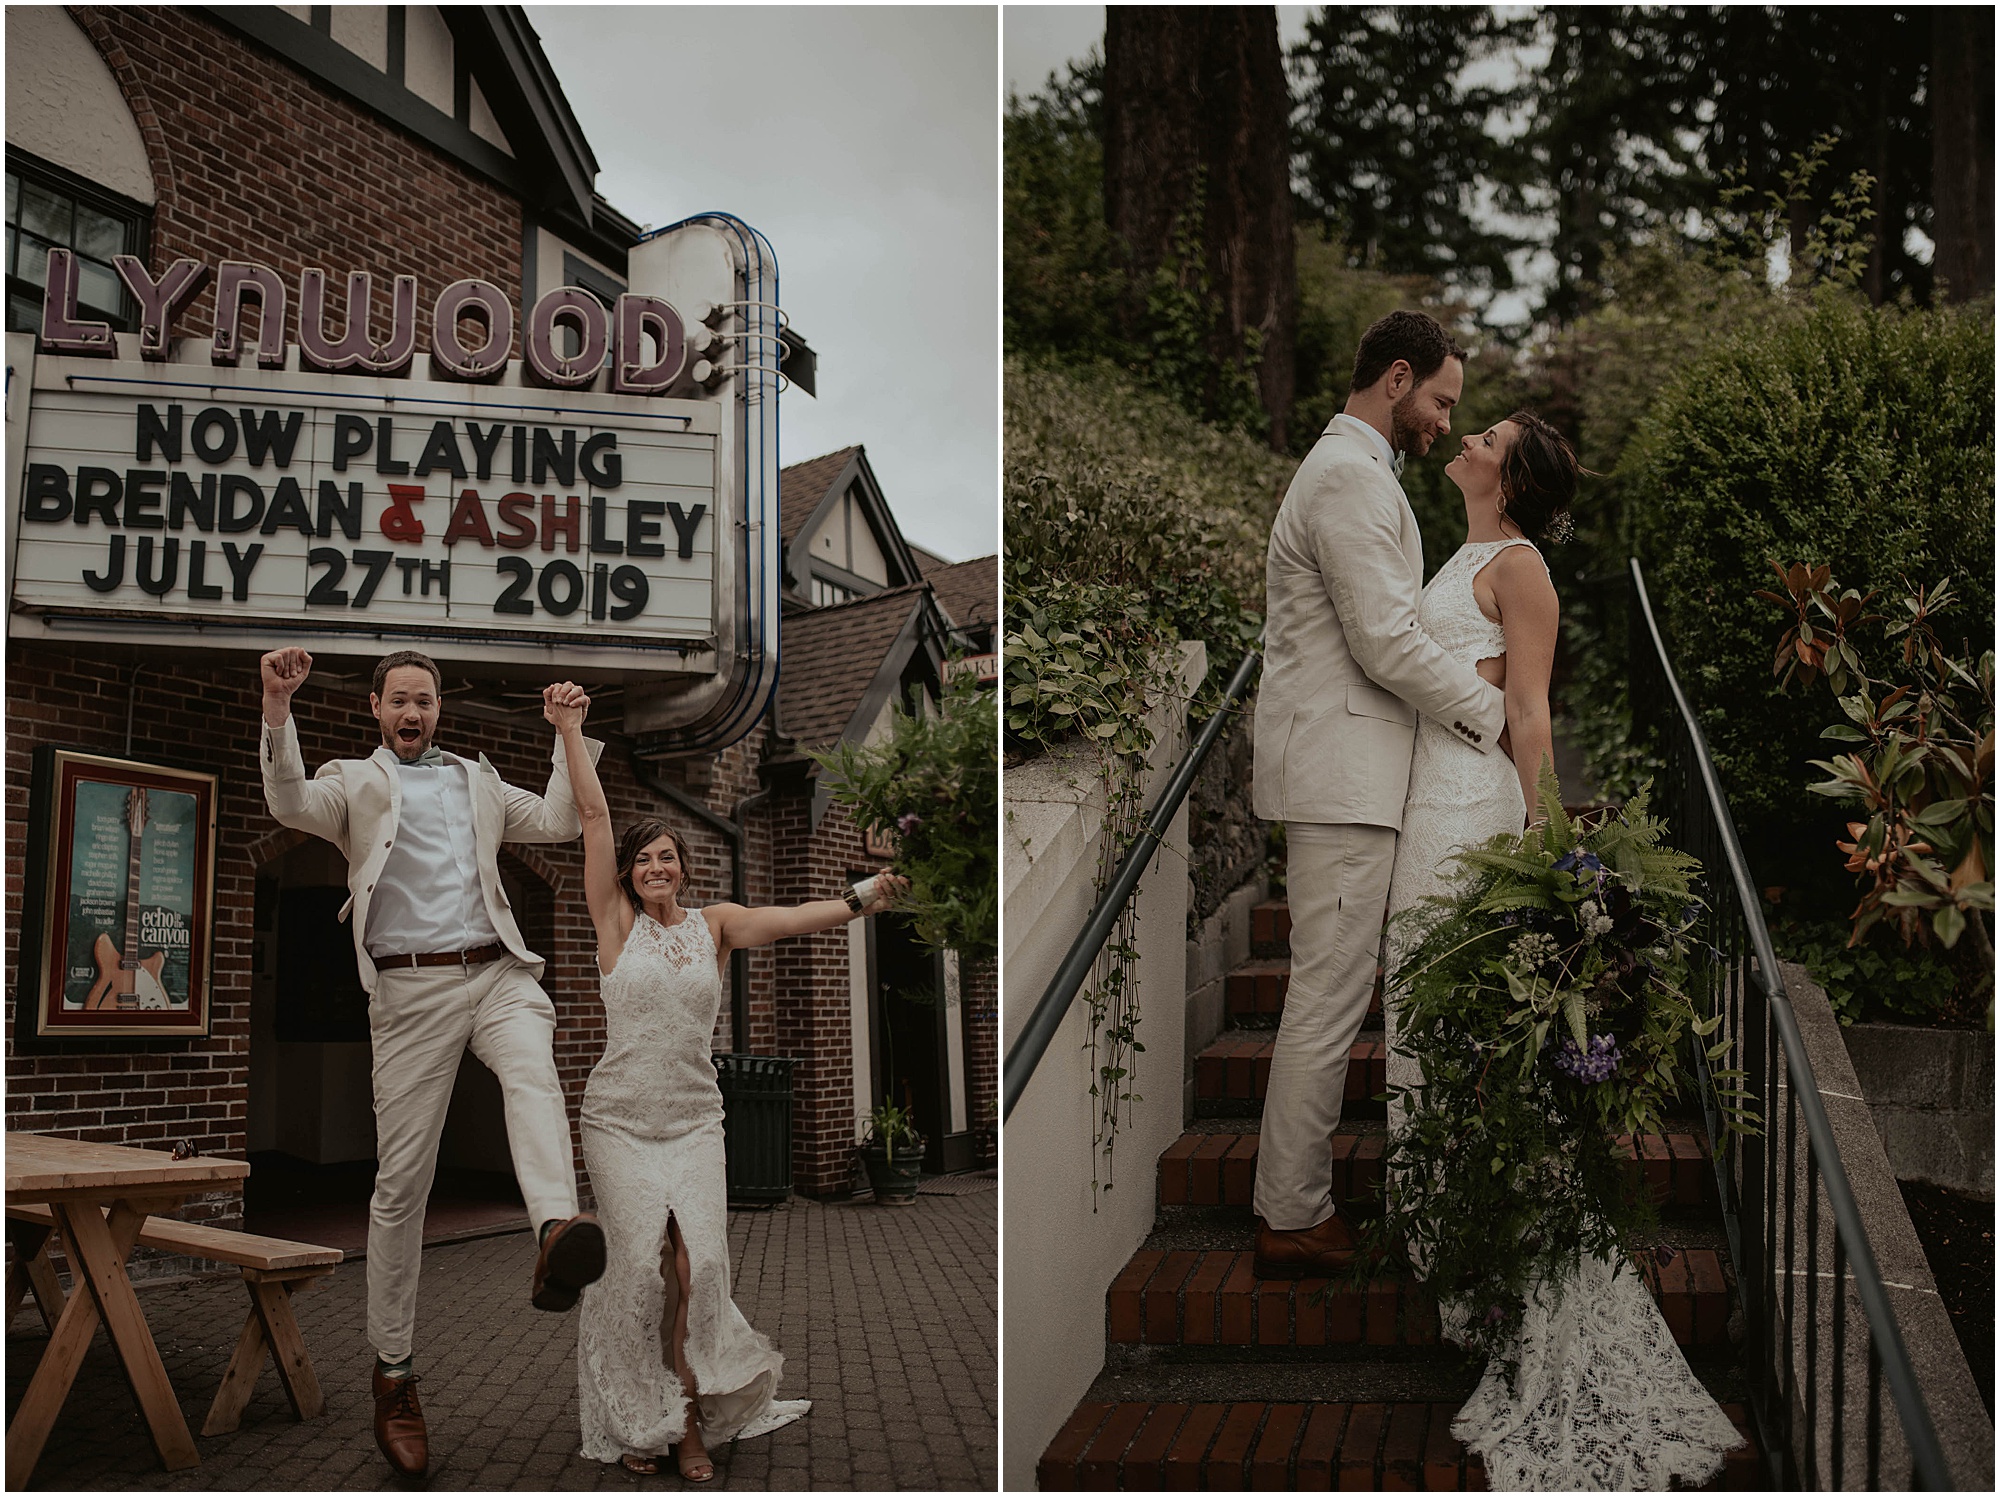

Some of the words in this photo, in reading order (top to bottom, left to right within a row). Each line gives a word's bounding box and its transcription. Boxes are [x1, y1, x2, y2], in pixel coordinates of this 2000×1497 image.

[40, 247, 688, 396] LYNWOOD
[136, 403, 304, 469] NOW
[333, 413, 622, 489] PLAYING
[24, 462, 363, 541] BRENDAN
[380, 483, 425, 543] &
[442, 488, 707, 558] ASHLEY
[82, 534, 265, 602] JULY
[305, 547, 450, 608] 27TH
[493, 555, 650, 621] 2019
[79, 897, 98, 906] jackson
[141, 906, 174, 928] echo
[174, 911, 181, 921] in
[174, 919, 184, 928] the
[141, 927, 190, 949] canyon
